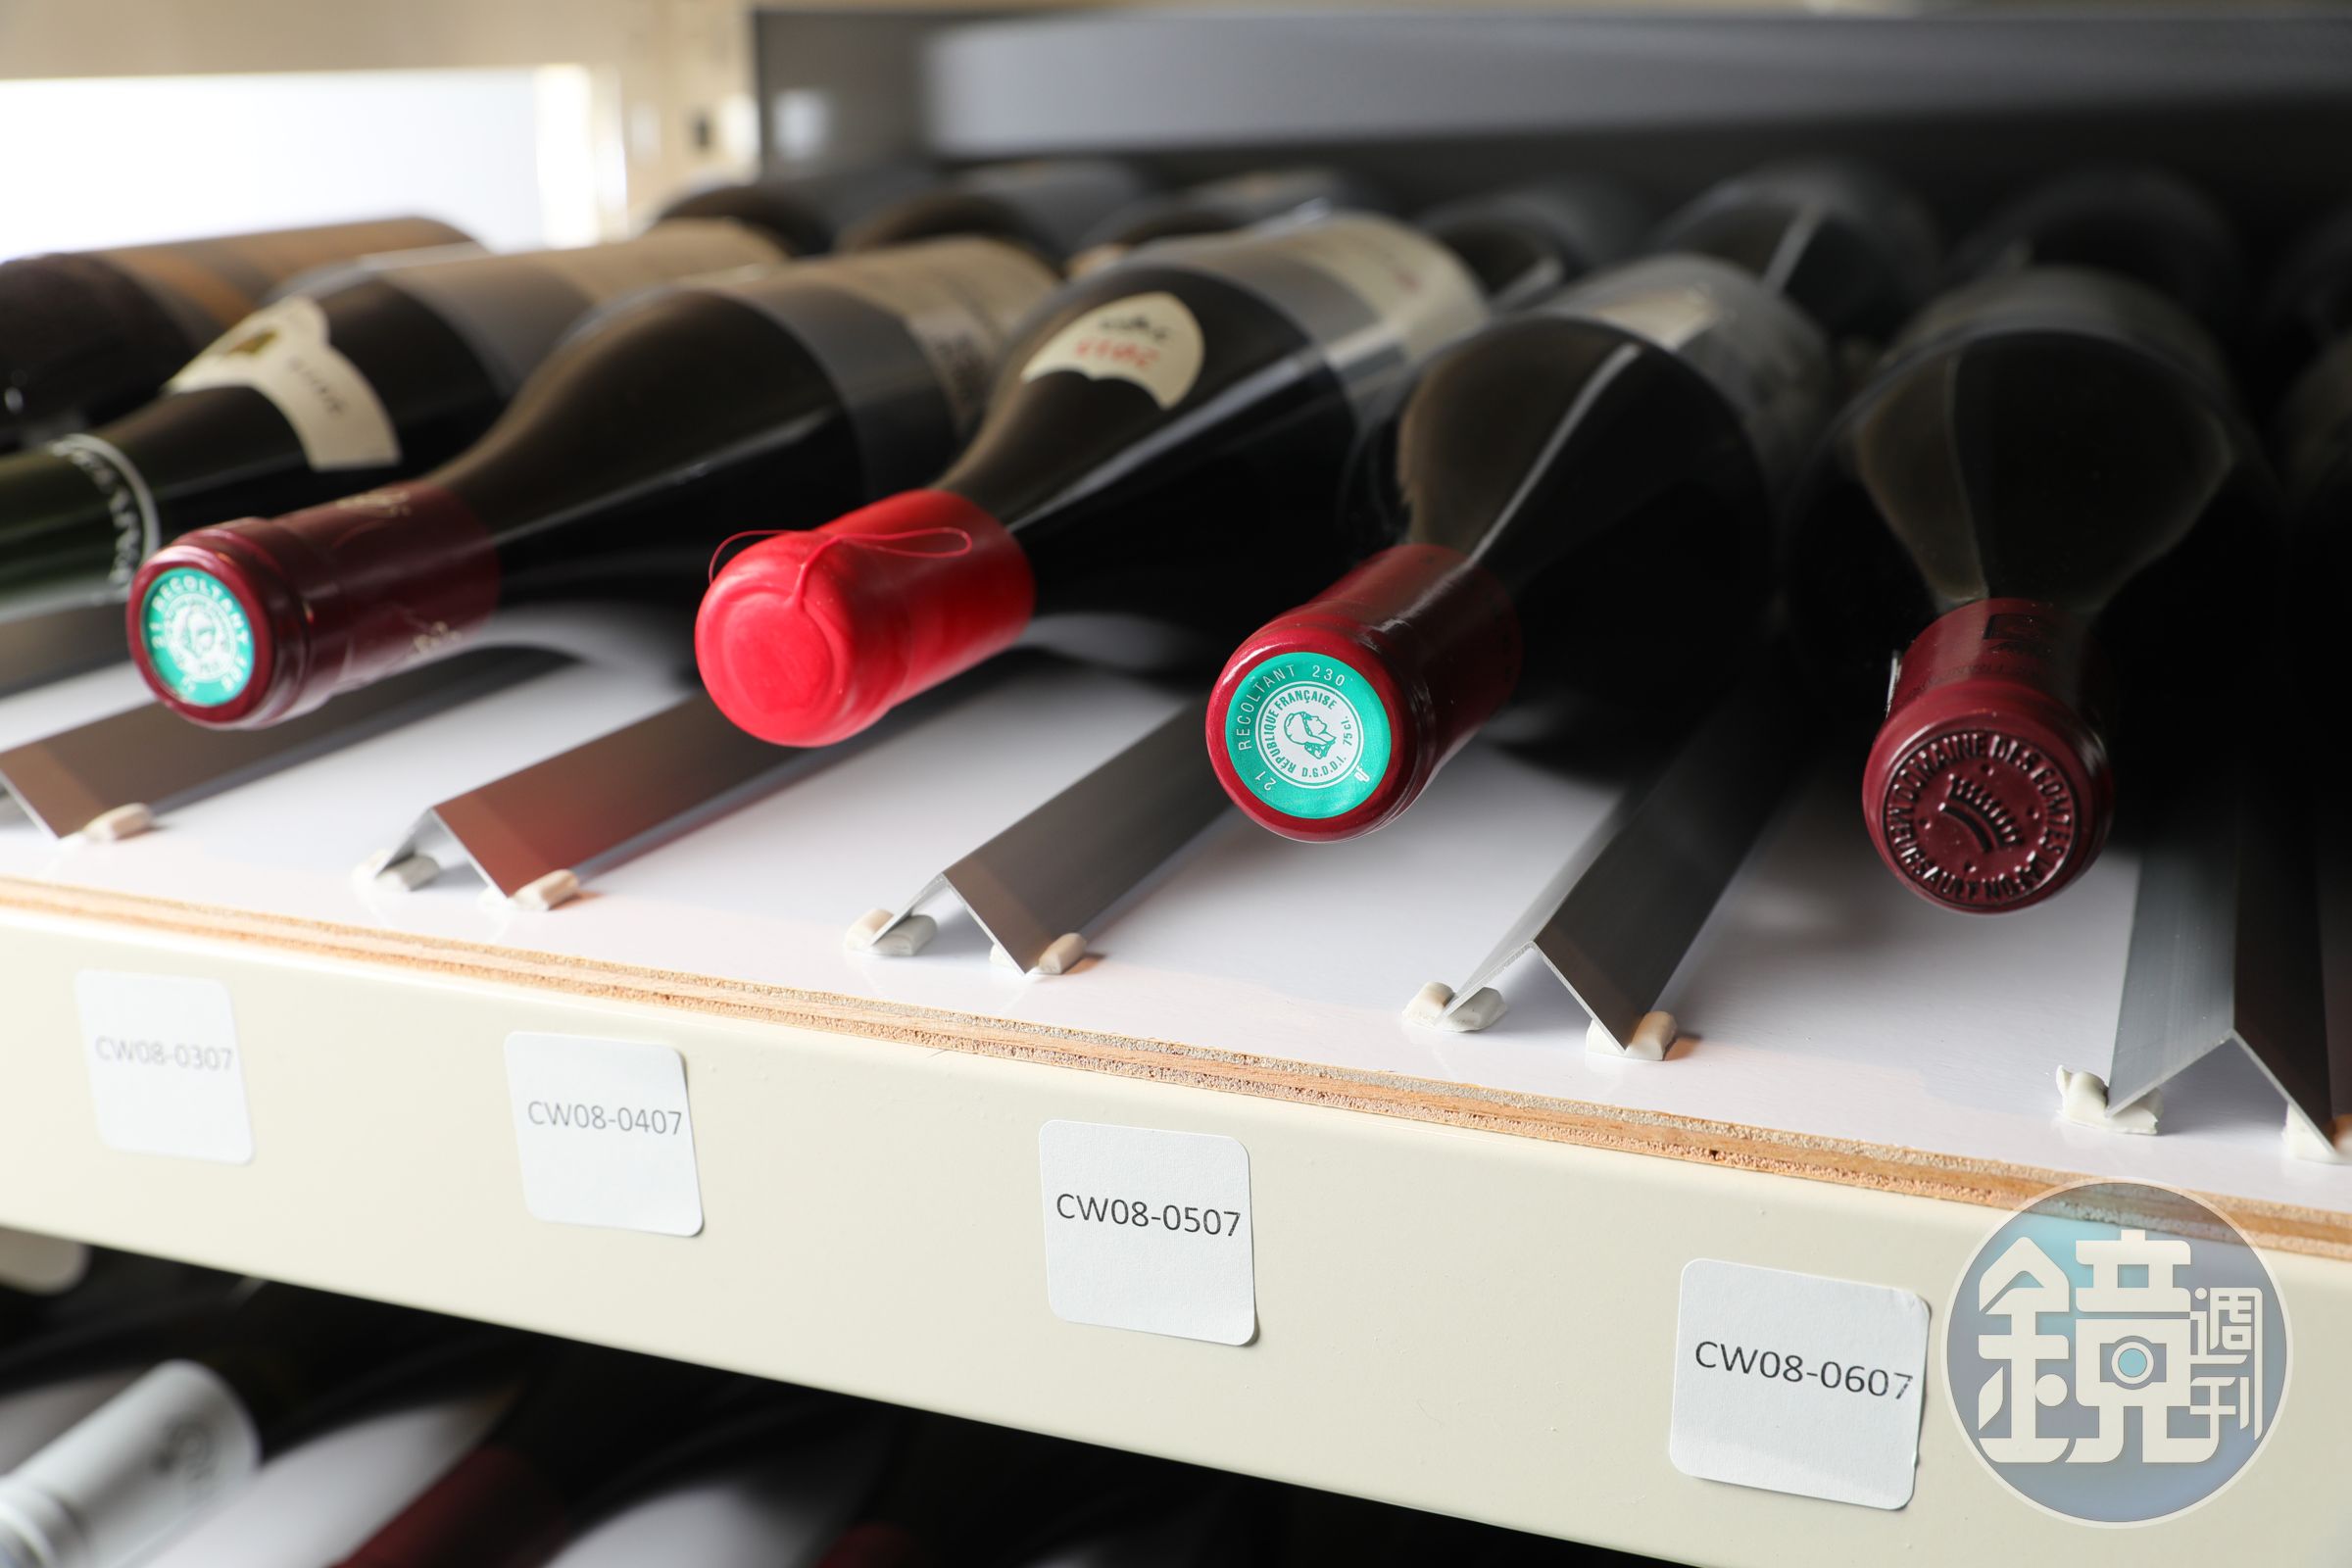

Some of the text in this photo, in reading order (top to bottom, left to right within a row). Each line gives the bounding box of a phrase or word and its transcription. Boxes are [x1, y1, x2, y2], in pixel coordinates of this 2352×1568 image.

[1237, 664, 1346, 791] 21 RECOLTANT 230
[1261, 689, 1338, 774] RÉPUBLIQUE FRANÇAISE
[95, 1035, 233, 1071] CW08-0307
[527, 1101, 683, 1136] CW08-0407
[1056, 1193, 1241, 1237] CW08-0507
[1694, 1341, 1914, 1400] CW08-0607
